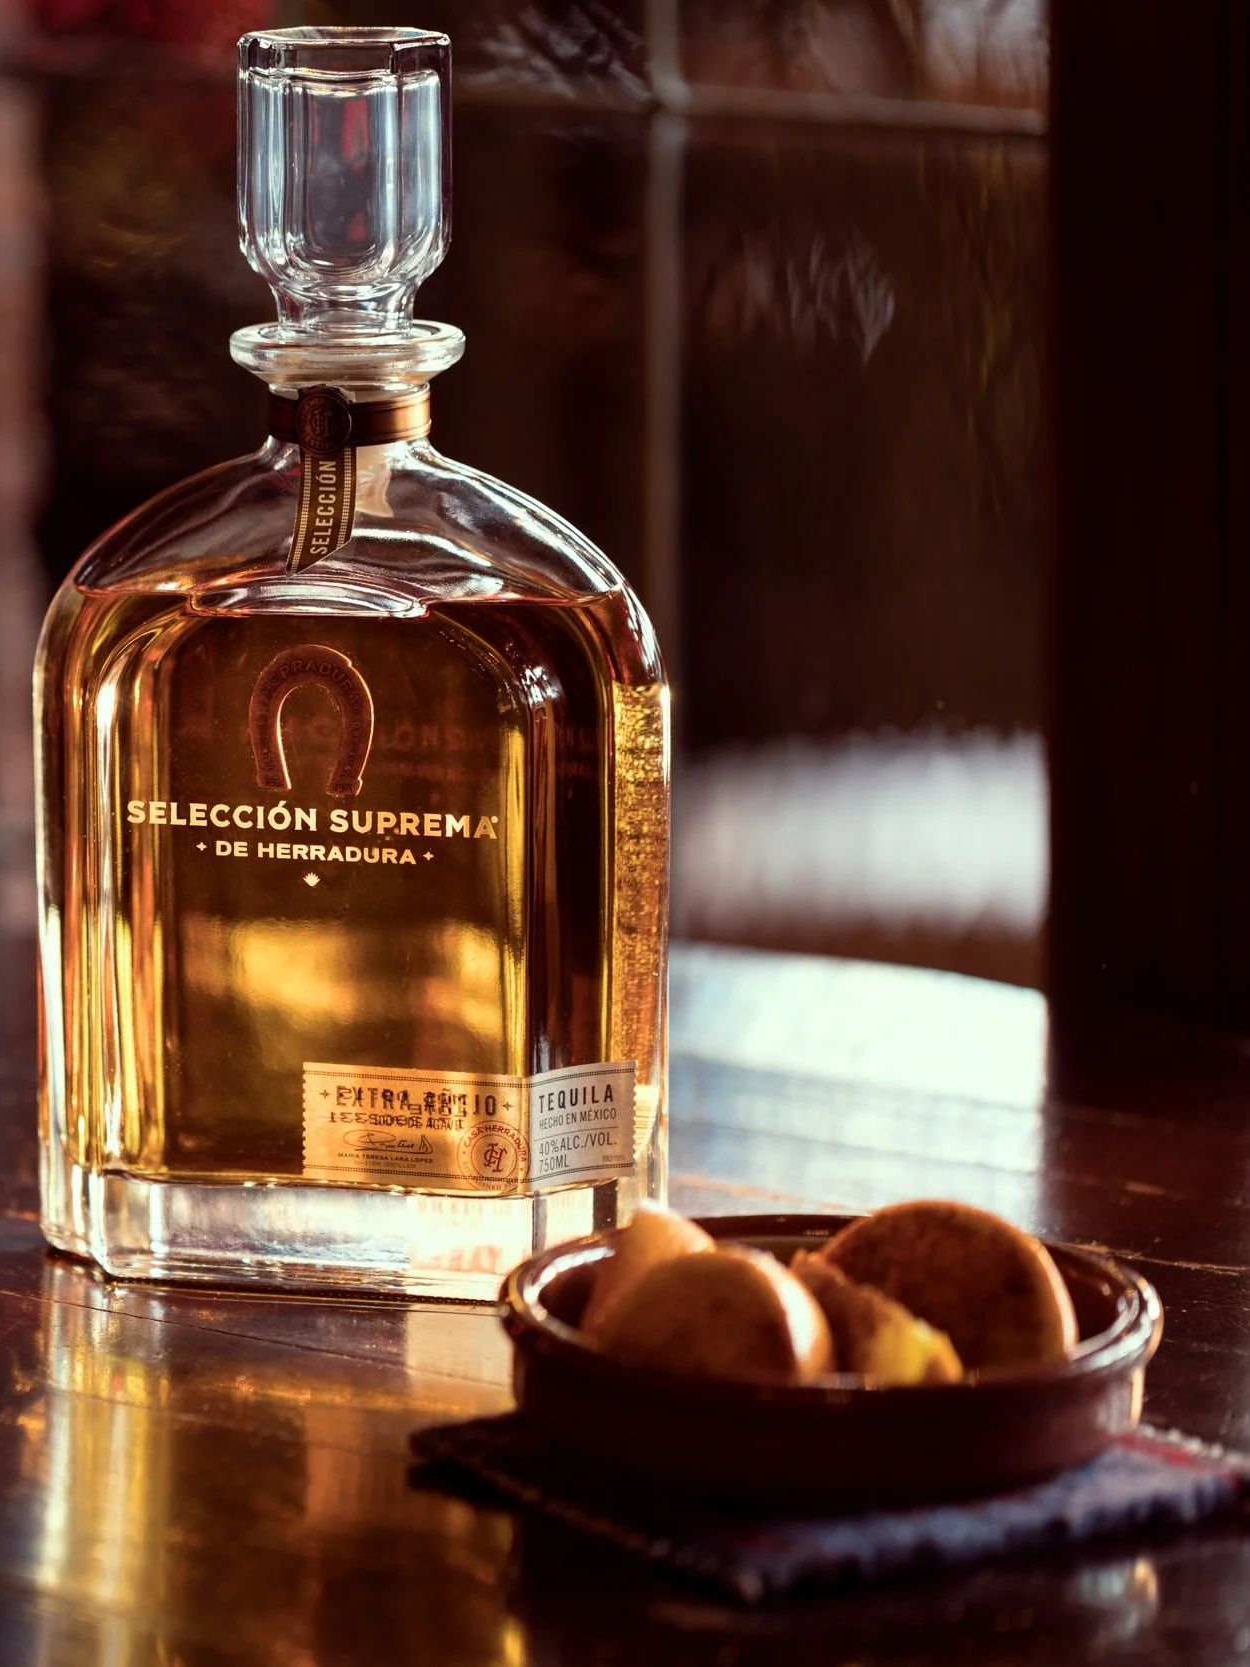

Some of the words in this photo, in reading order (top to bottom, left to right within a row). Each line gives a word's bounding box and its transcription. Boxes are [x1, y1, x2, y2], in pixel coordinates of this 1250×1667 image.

[310, 460, 337, 555] SELECCIÓN
[126, 800, 317, 832] SELECCIÓN
[330, 809, 498, 839] SUPREMA
[215, 841, 248, 857] DE
[258, 843, 416, 865] HERRADURA
[336, 1085, 410, 1110] EXTRA
[538, 1084, 614, 1114] TEQUILA
[539, 1114, 564, 1130] HECHO
[566, 1112, 577, 1125] EN
[579, 1107, 617, 1122] MÉXICO
[463, 1128, 484, 1148] CASA
[485, 1124, 527, 1163] HERRADURA
[362, 1154, 389, 1162] TERESA
[410, 1155, 434, 1163] LÓPEZ
[539, 1154, 570, 1174] 750ML
